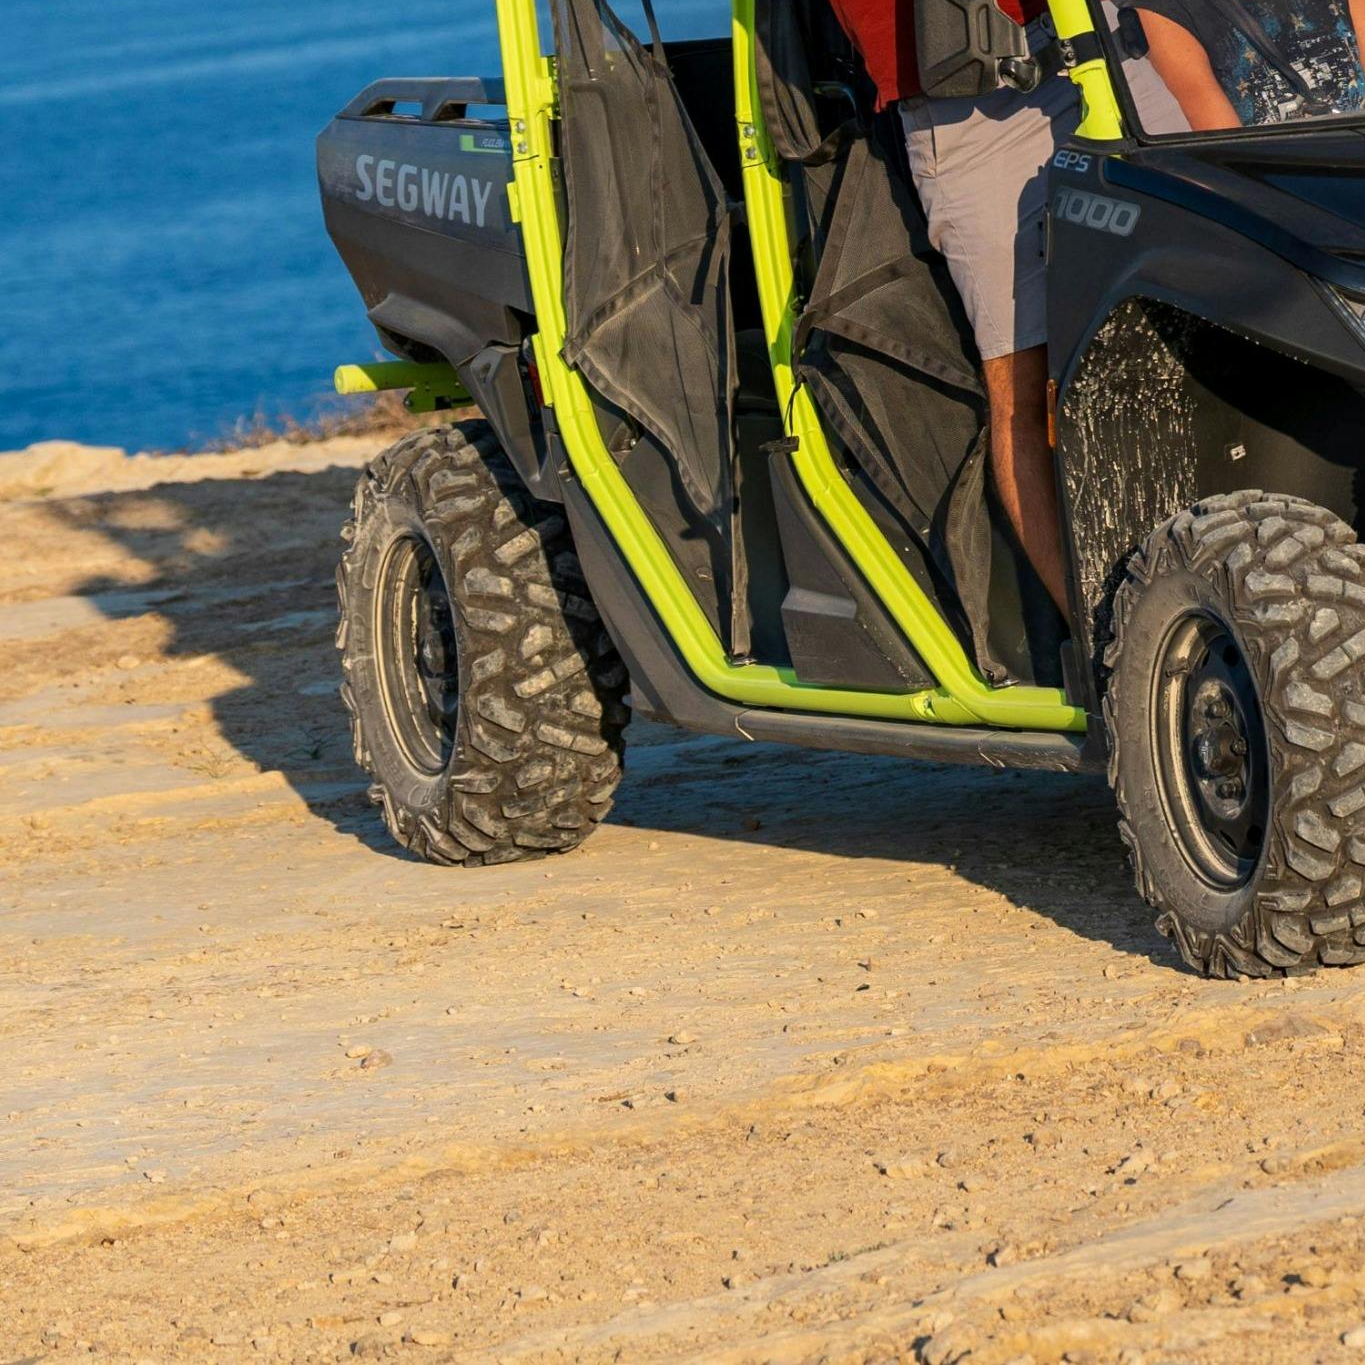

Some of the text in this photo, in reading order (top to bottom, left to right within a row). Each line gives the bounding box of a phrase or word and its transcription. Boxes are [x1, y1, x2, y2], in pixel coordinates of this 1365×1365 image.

[1053, 150, 1092, 172] EPS
[355, 154, 493, 228] SEGWAY
[1055, 191, 1140, 237] 1000
